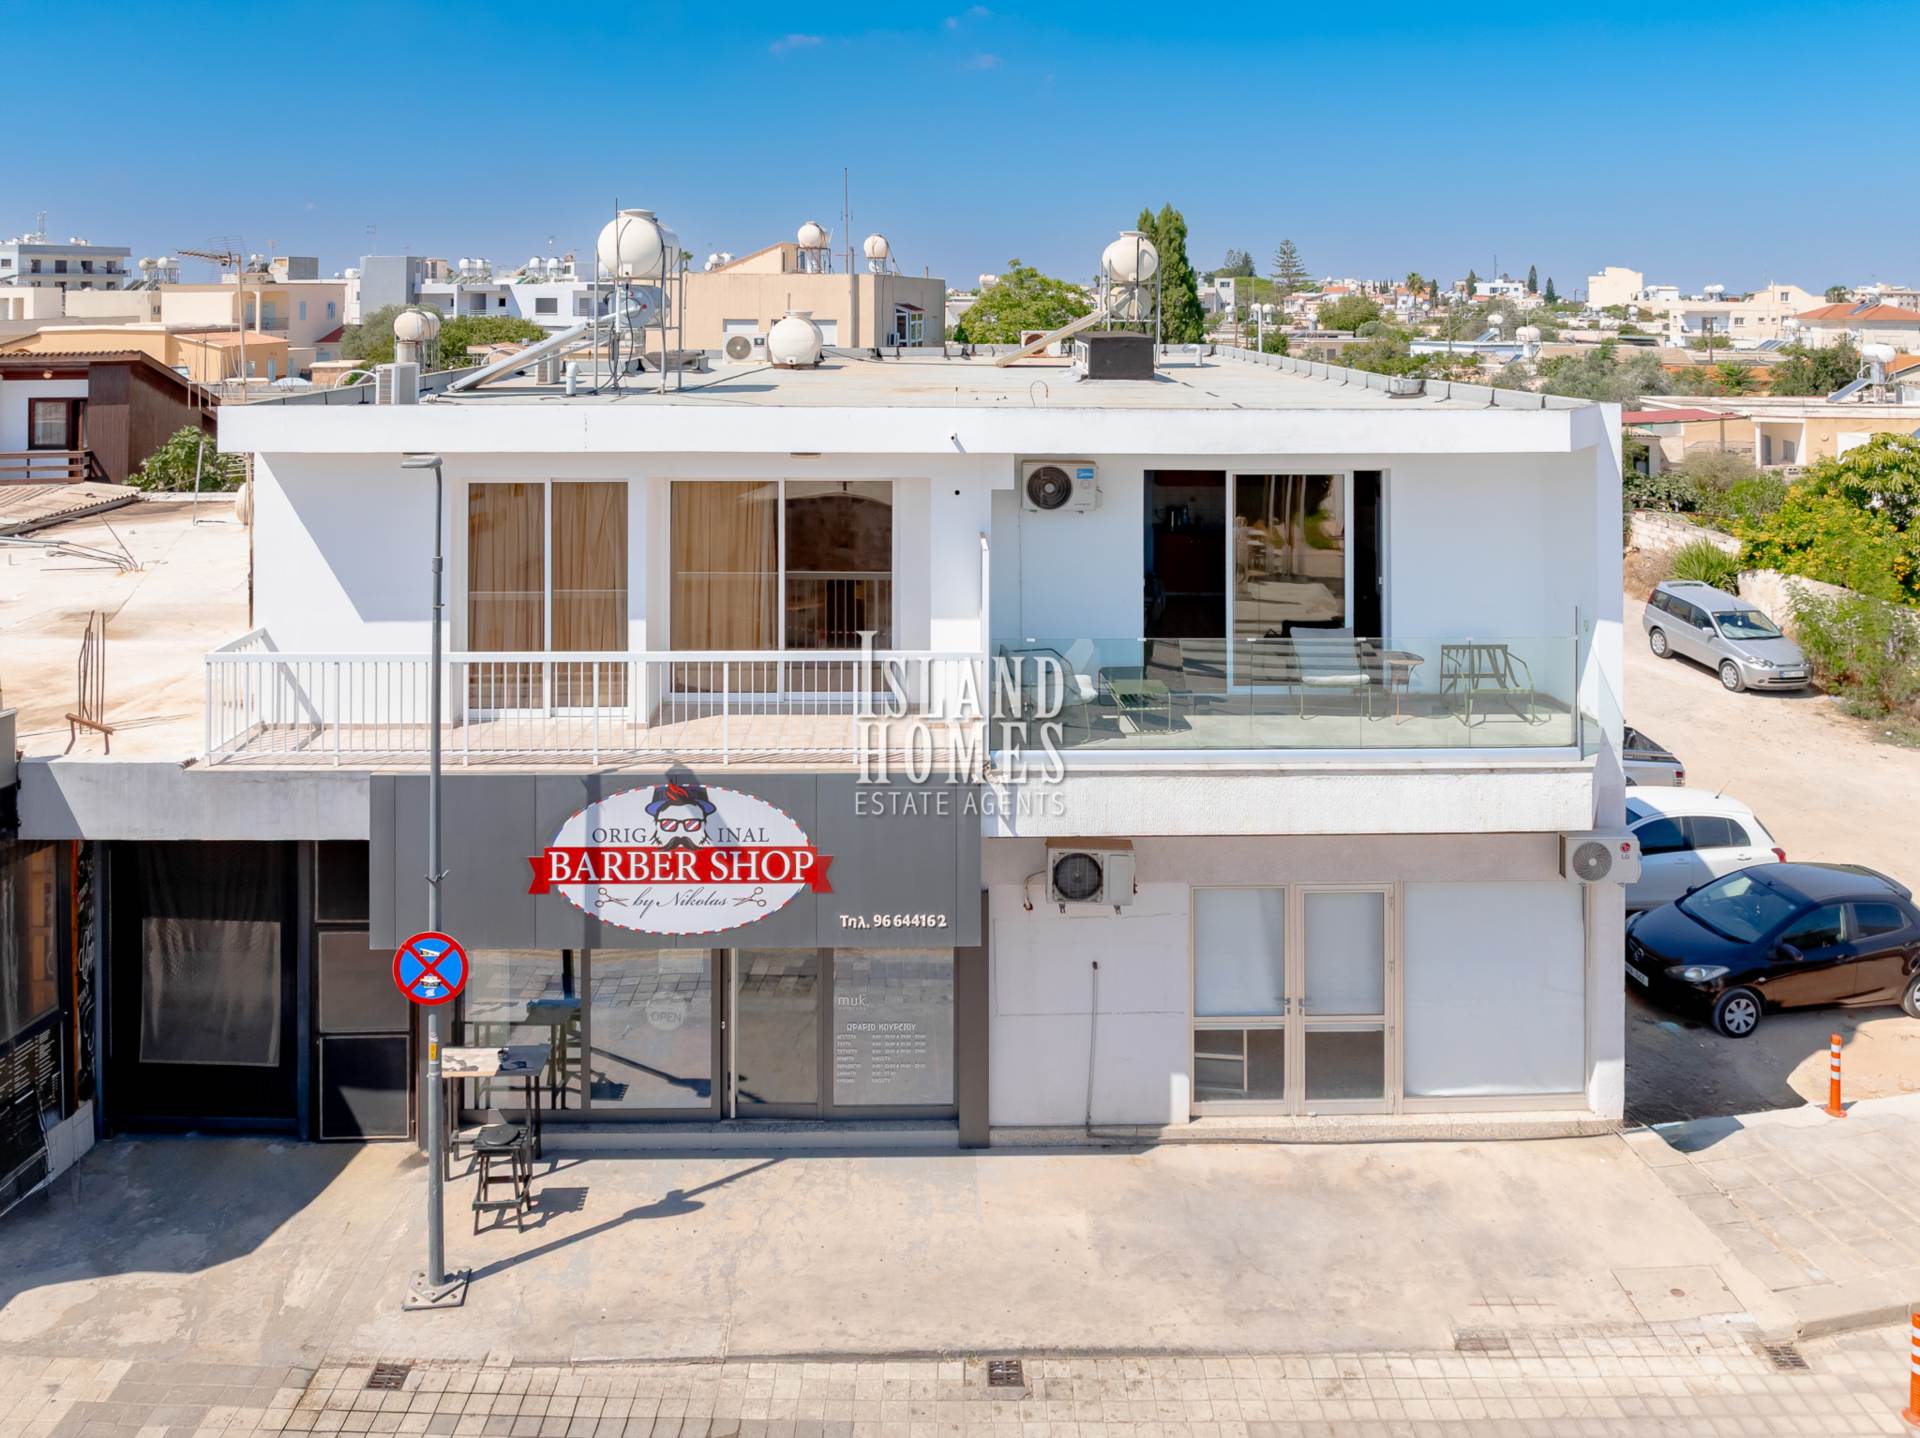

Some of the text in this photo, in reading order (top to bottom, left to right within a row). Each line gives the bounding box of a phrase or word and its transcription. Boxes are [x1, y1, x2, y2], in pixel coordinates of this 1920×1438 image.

[548, 850, 814, 881] BARBER SHOP
[632, 887, 654, 919] by
[651, 1011, 681, 1023] OPEN
